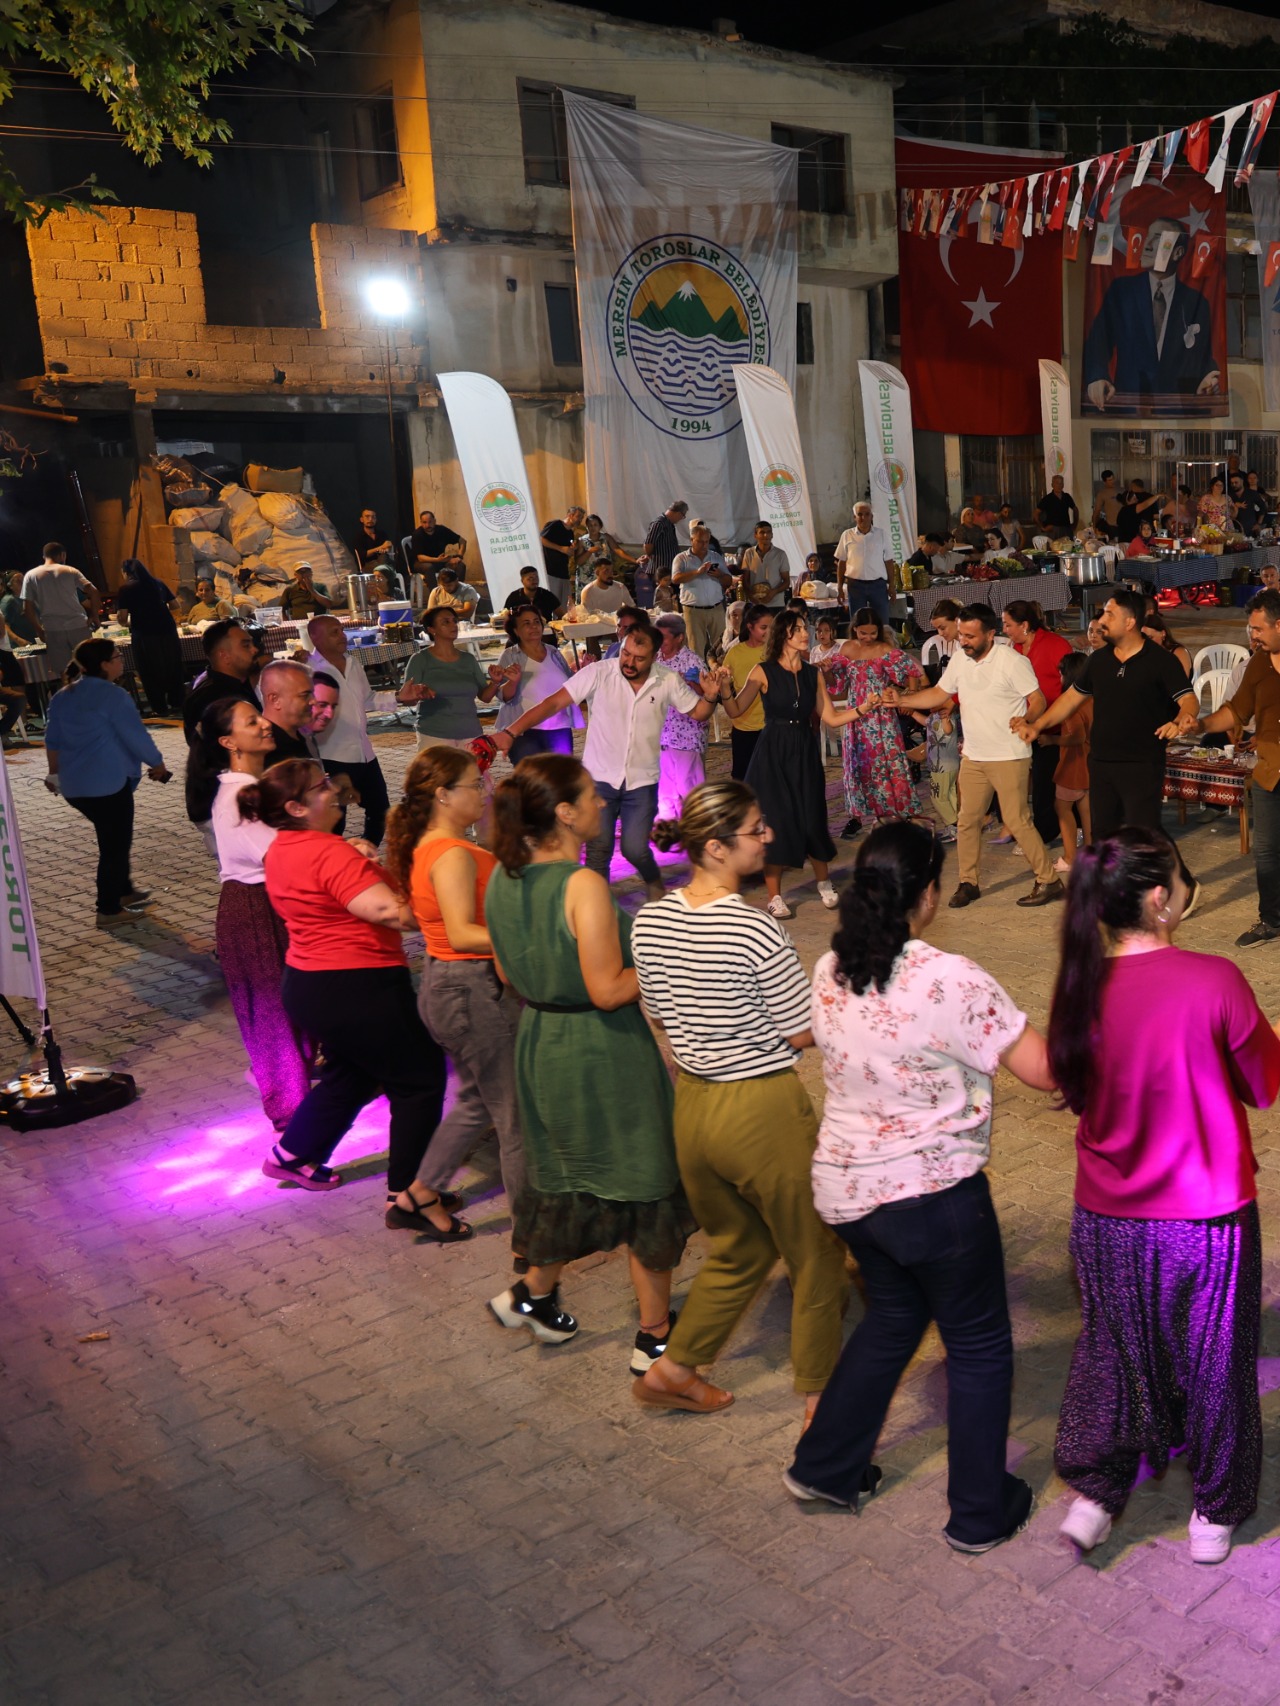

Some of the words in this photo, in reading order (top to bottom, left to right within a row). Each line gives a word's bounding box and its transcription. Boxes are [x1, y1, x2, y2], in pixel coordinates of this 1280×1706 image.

[630, 241, 721, 277] TOROSLAR
[724, 261, 768, 365] BELEDİYES
[671, 417, 712, 433] 1994
